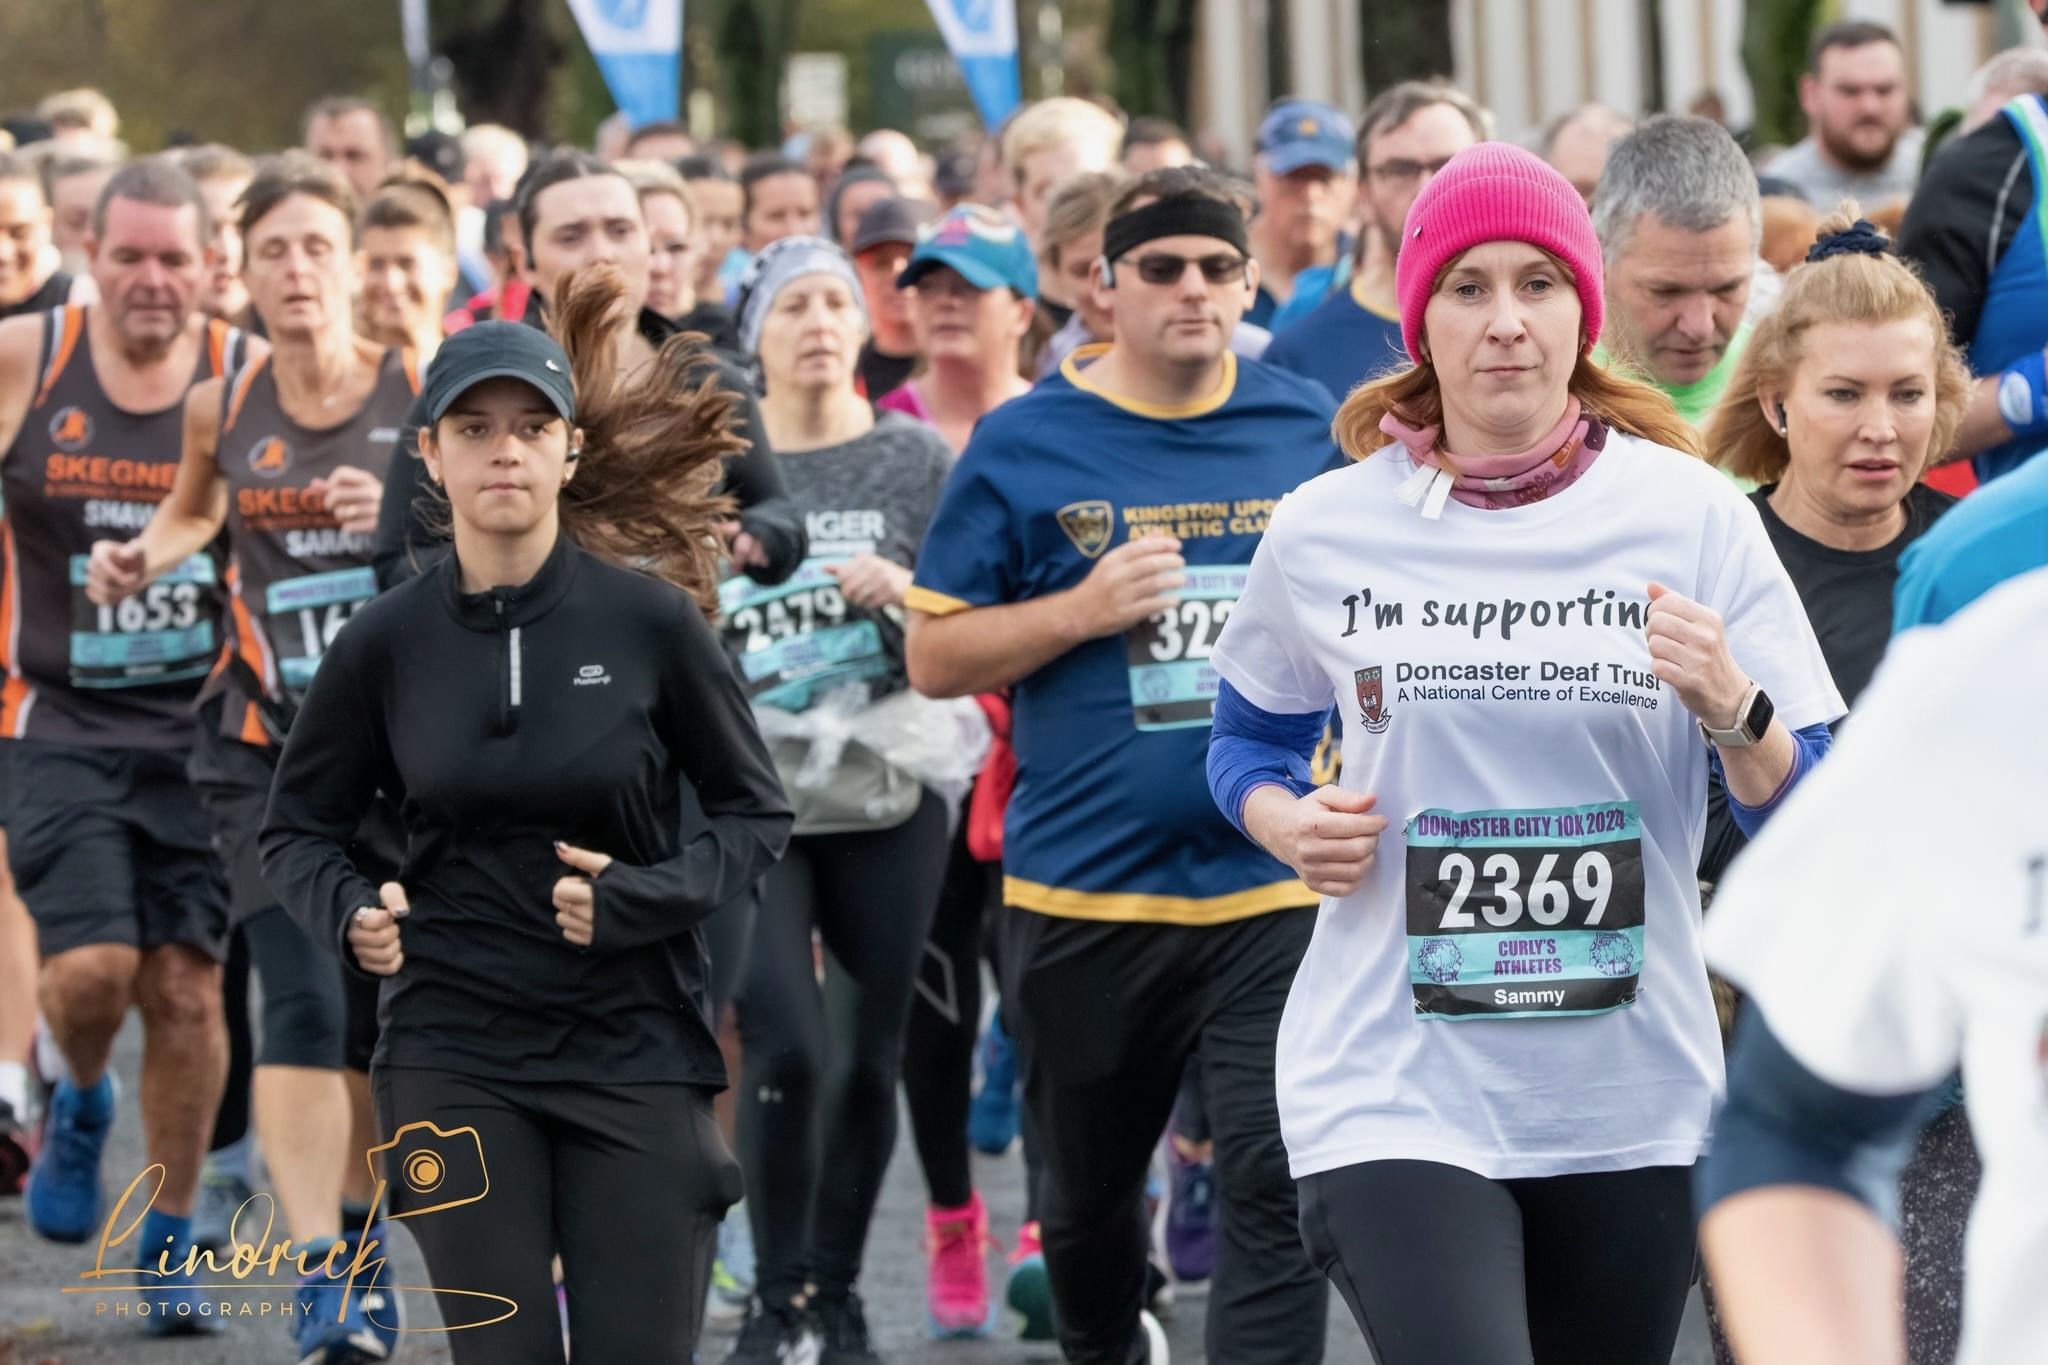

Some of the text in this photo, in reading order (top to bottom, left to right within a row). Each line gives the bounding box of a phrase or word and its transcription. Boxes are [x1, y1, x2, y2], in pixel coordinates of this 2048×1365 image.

[1123, 501, 1228, 523] KINGSTON
[97, 582, 199, 633] 1653
[1340, 587, 1652, 641] I'm supportin
[1396, 660, 1531, 683] Doncaster
[1540, 661, 1600, 683] Deaf
[1397, 684, 1658, 711] A National Centre of Excellence
[1417, 808, 1626, 839] DONCASTER CITY 10K 2024
[1437, 850, 1614, 930] 2369
[1498, 938, 1557, 957] CURLY'S
[1493, 958, 1562, 976] ATHLETES
[1493, 988, 1566, 1007] Sammy
